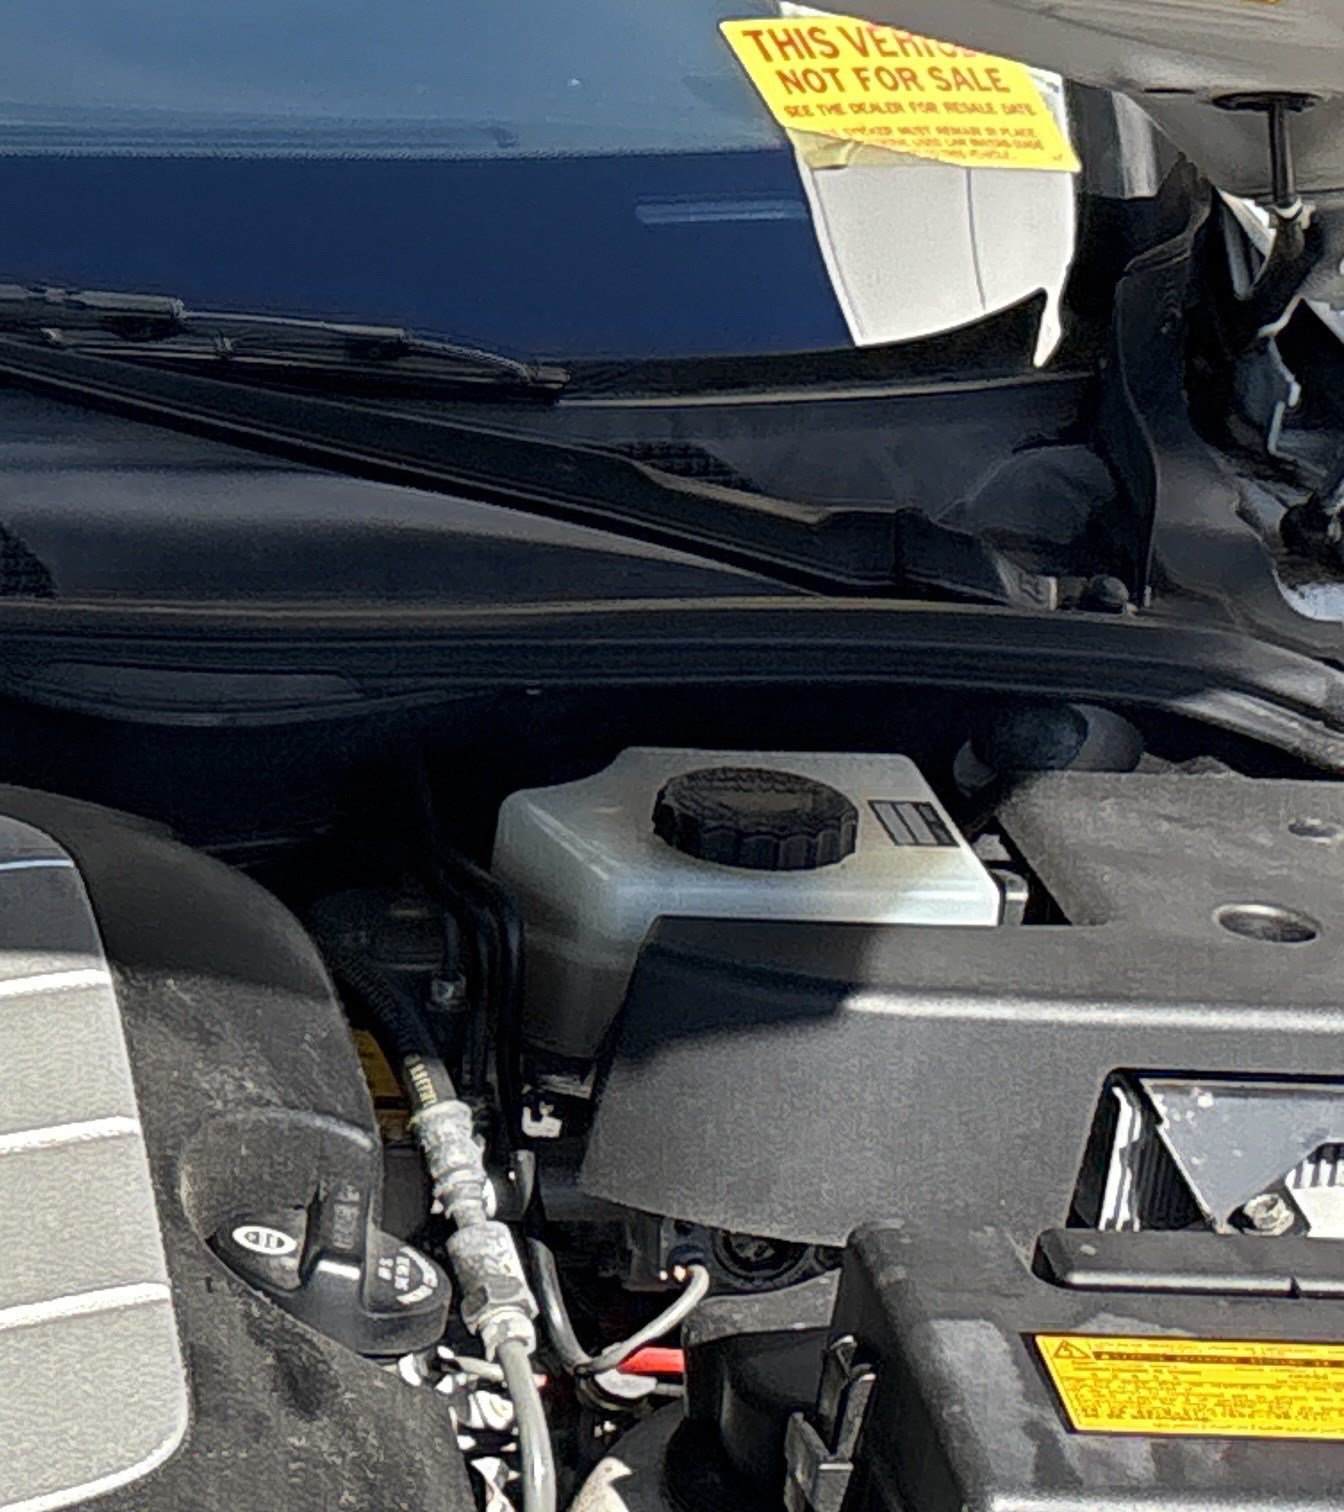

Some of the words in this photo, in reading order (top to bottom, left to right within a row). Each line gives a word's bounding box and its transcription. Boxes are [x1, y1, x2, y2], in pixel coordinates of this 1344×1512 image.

[741, 26, 840, 62] THIS
[776, 67, 847, 95] NOT
[852, 66, 925, 93] FOR
[928, 67, 1011, 94] SALE
[784, 104, 814, 118] SEE
[818, 103, 848, 115] THE
[849, 102, 904, 115] DEALER
[909, 102, 939, 114] FOR
[943, 102, 997, 115] RESALE
